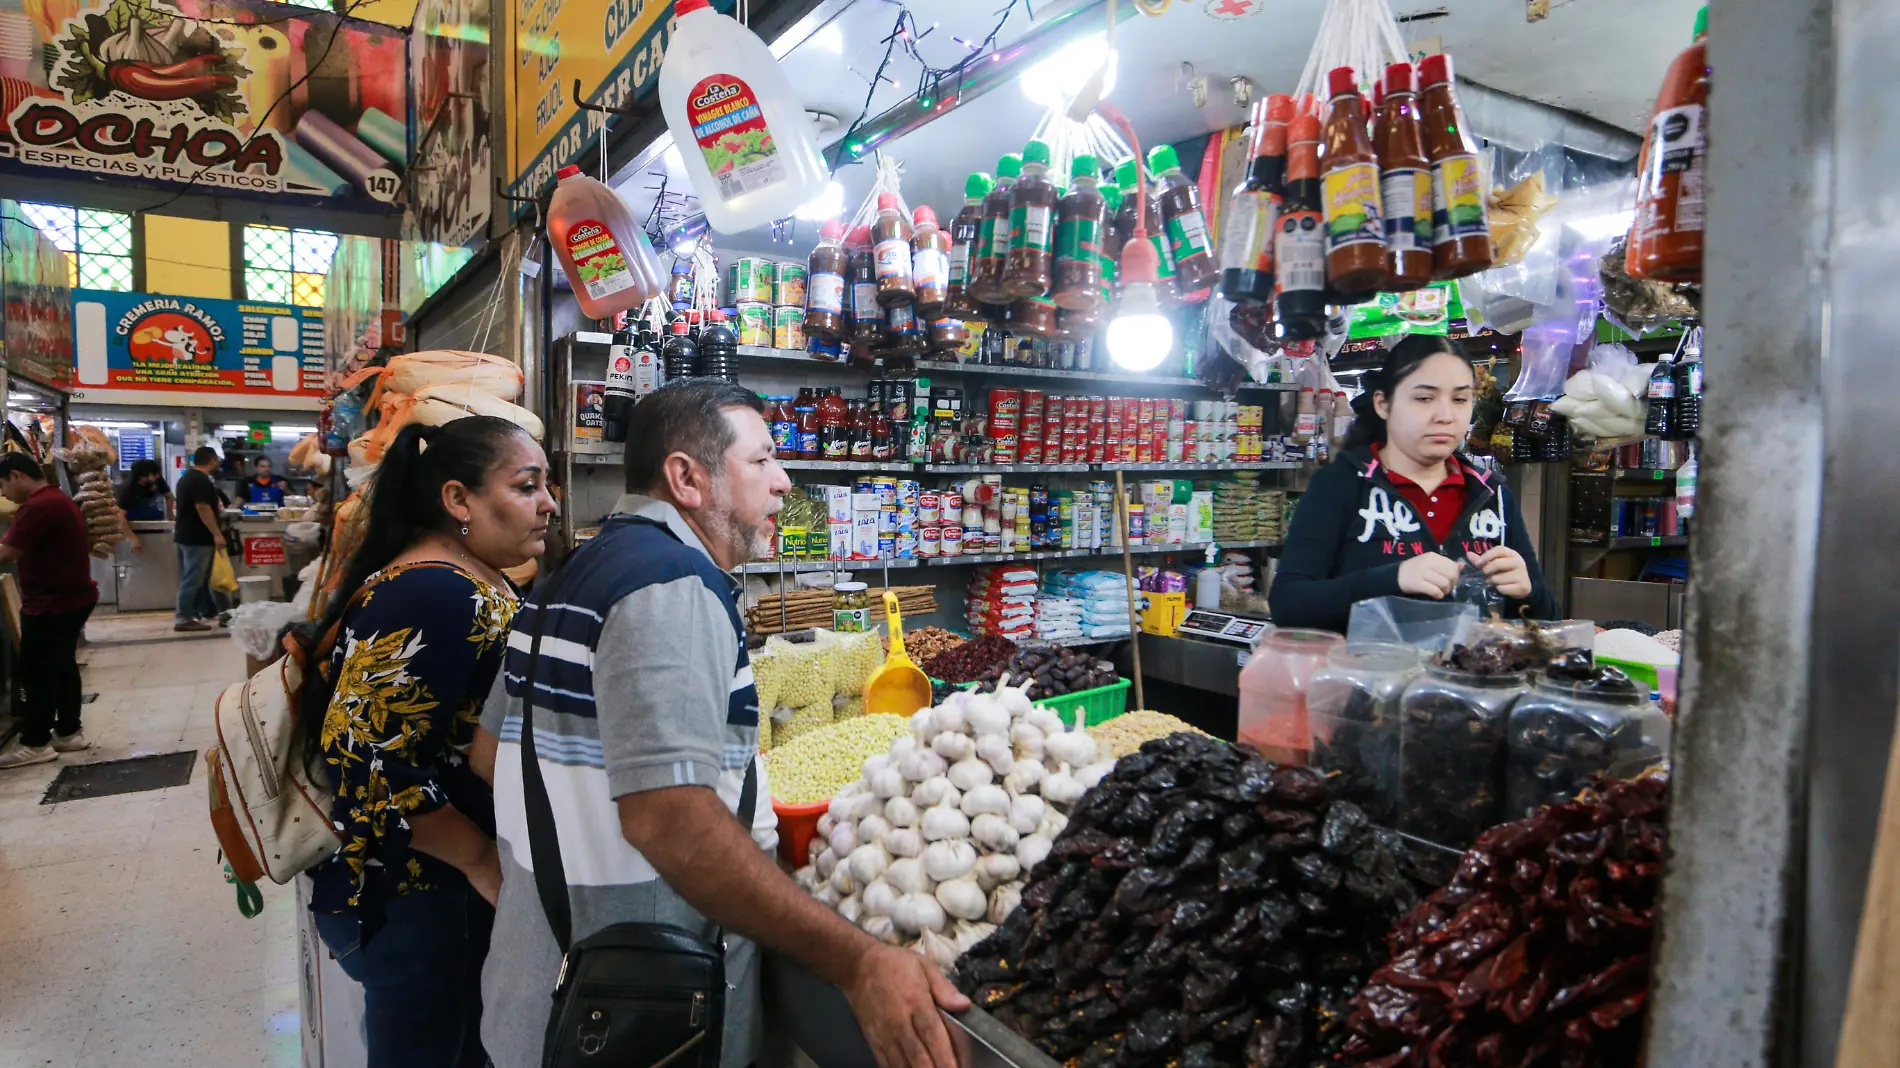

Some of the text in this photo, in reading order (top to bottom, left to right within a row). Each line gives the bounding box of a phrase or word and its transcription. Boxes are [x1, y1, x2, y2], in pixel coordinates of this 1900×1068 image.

[696, 84, 738, 108] Costeña
[709, 85, 720, 94] La
[695, 96, 750, 125] VINAGRE BLANCO
[694, 126, 706, 140] DE
[705, 117, 733, 136] ALCOHOL
[732, 113, 742, 126] DE
[14, 103, 283, 176] OCHOA
[25, 150, 278, 189] ESPECIAS Y PLASTICOS
[368, 175, 396, 195] 147
[573, 227, 600, 241] Costeña
[116, 299, 225, 342] CREMERIA RAMOS
[178, 363, 212, 371] CALIDAD
[1383, 540, 1424, 555] NEW
